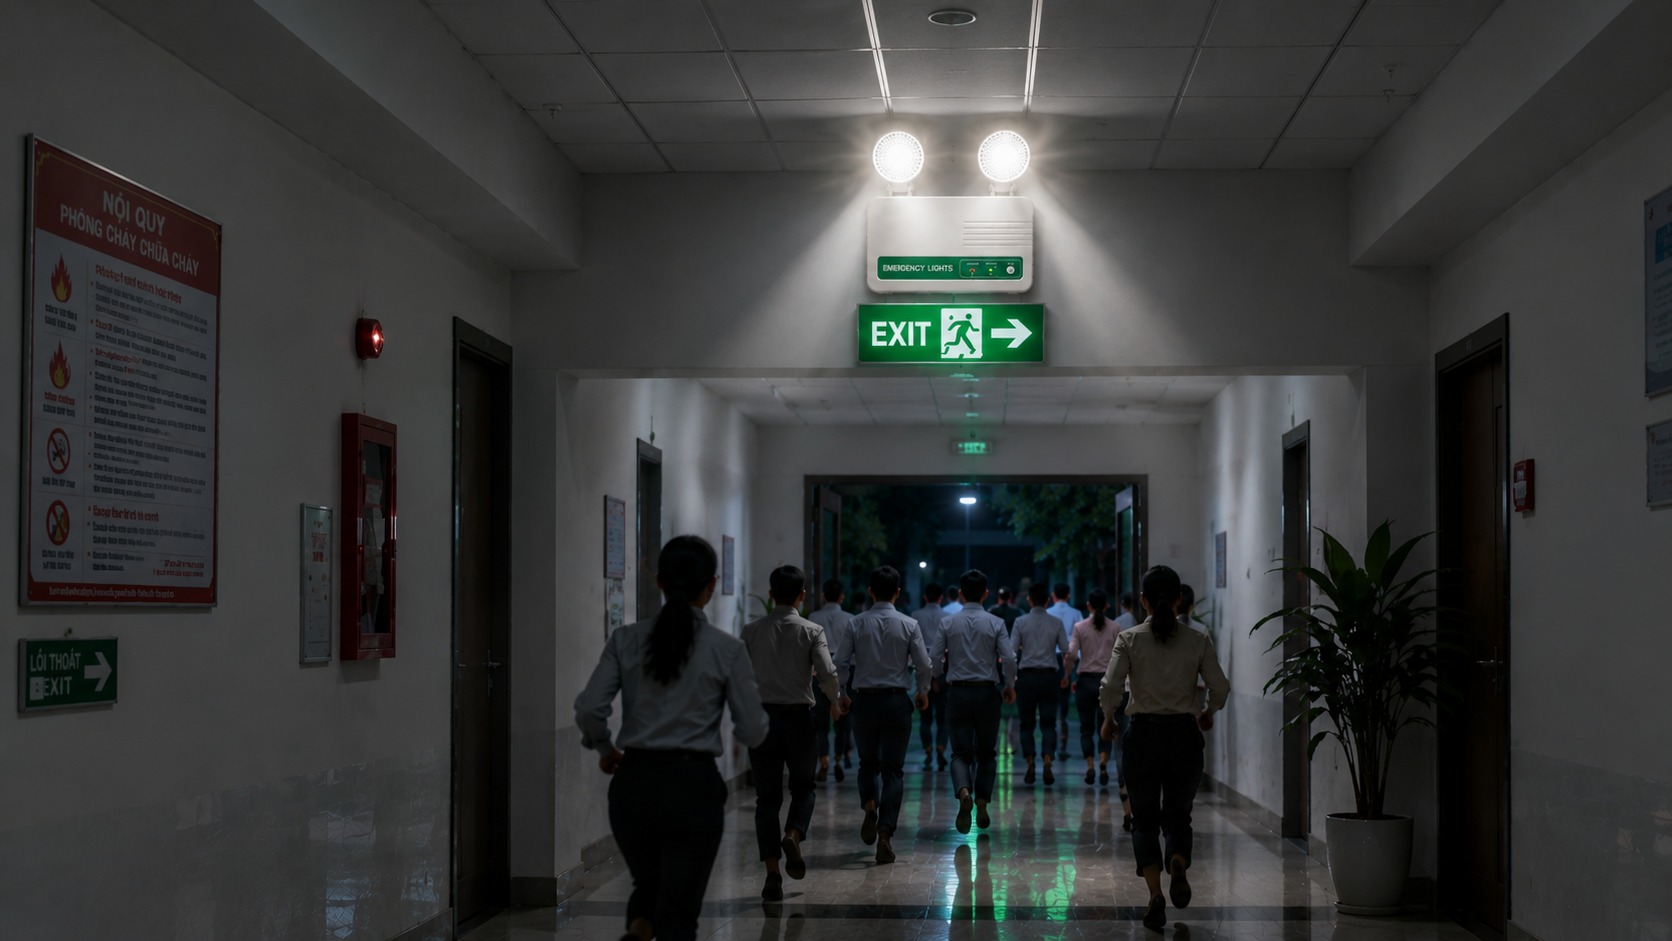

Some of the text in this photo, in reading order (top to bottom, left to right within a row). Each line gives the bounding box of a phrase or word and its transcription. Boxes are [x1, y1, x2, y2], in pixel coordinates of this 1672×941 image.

[102, 190, 166, 237] NỘI QUY
[172, 252, 200, 277] CHÁY
[927, 264, 954, 272] LIGHTS
[871, 321, 932, 347] EXIT
[48, 647, 82, 671] THOÁT
